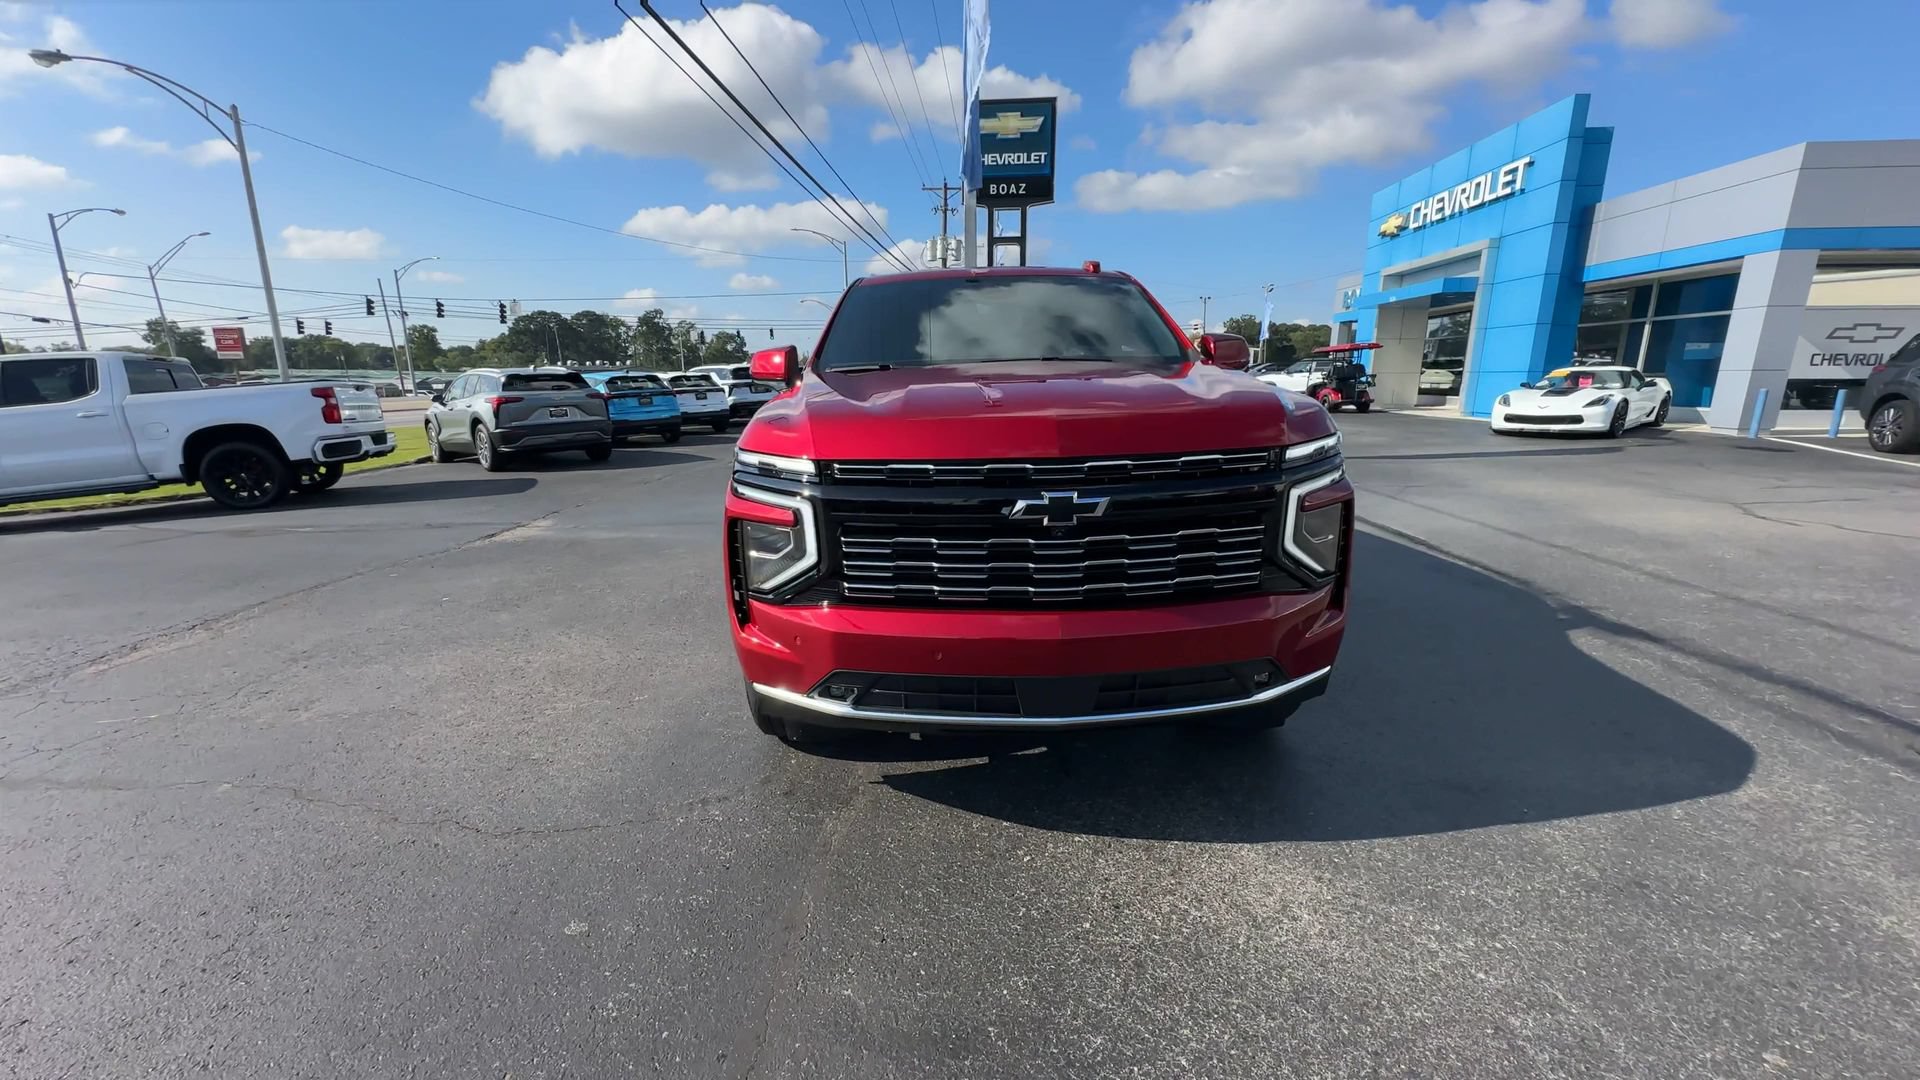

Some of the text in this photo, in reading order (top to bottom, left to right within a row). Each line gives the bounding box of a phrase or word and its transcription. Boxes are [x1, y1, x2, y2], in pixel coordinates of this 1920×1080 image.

[981, 152, 1048, 166] HEVROLET
[989, 183, 1027, 195] BOAZ
[1409, 155, 1532, 230] CHEVROLET
[1809, 353, 1897, 367] CHEVROL
